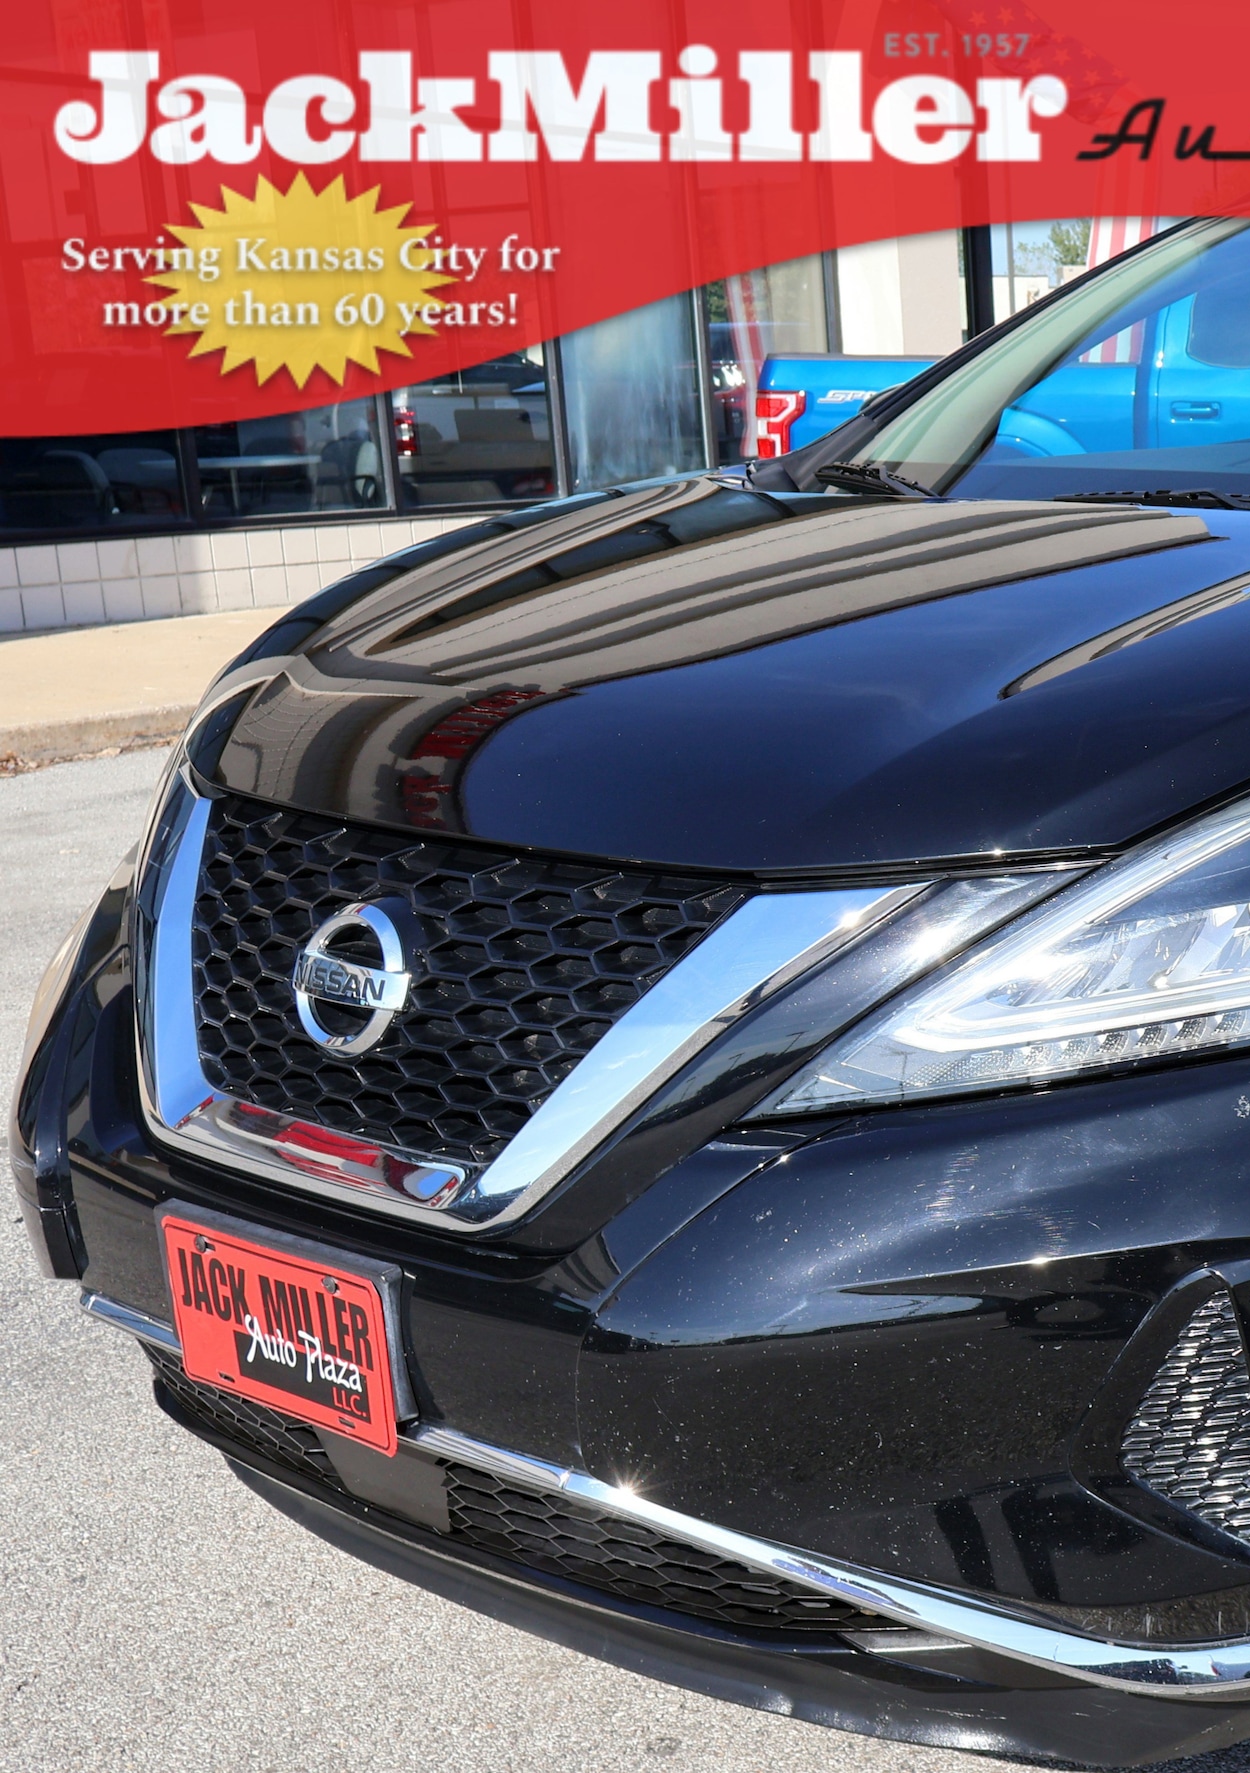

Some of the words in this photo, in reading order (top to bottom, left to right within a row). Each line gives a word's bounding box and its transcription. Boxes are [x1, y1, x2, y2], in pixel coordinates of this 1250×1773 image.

[296, 962, 386, 1001] NISSAN
[178, 1248, 250, 1325] JACK
[258, 1274, 374, 1371] MILLER
[244, 1313, 297, 1368] Auto
[297, 1330, 362, 1392] Plaza
[332, 1387, 367, 1417] LLC.
